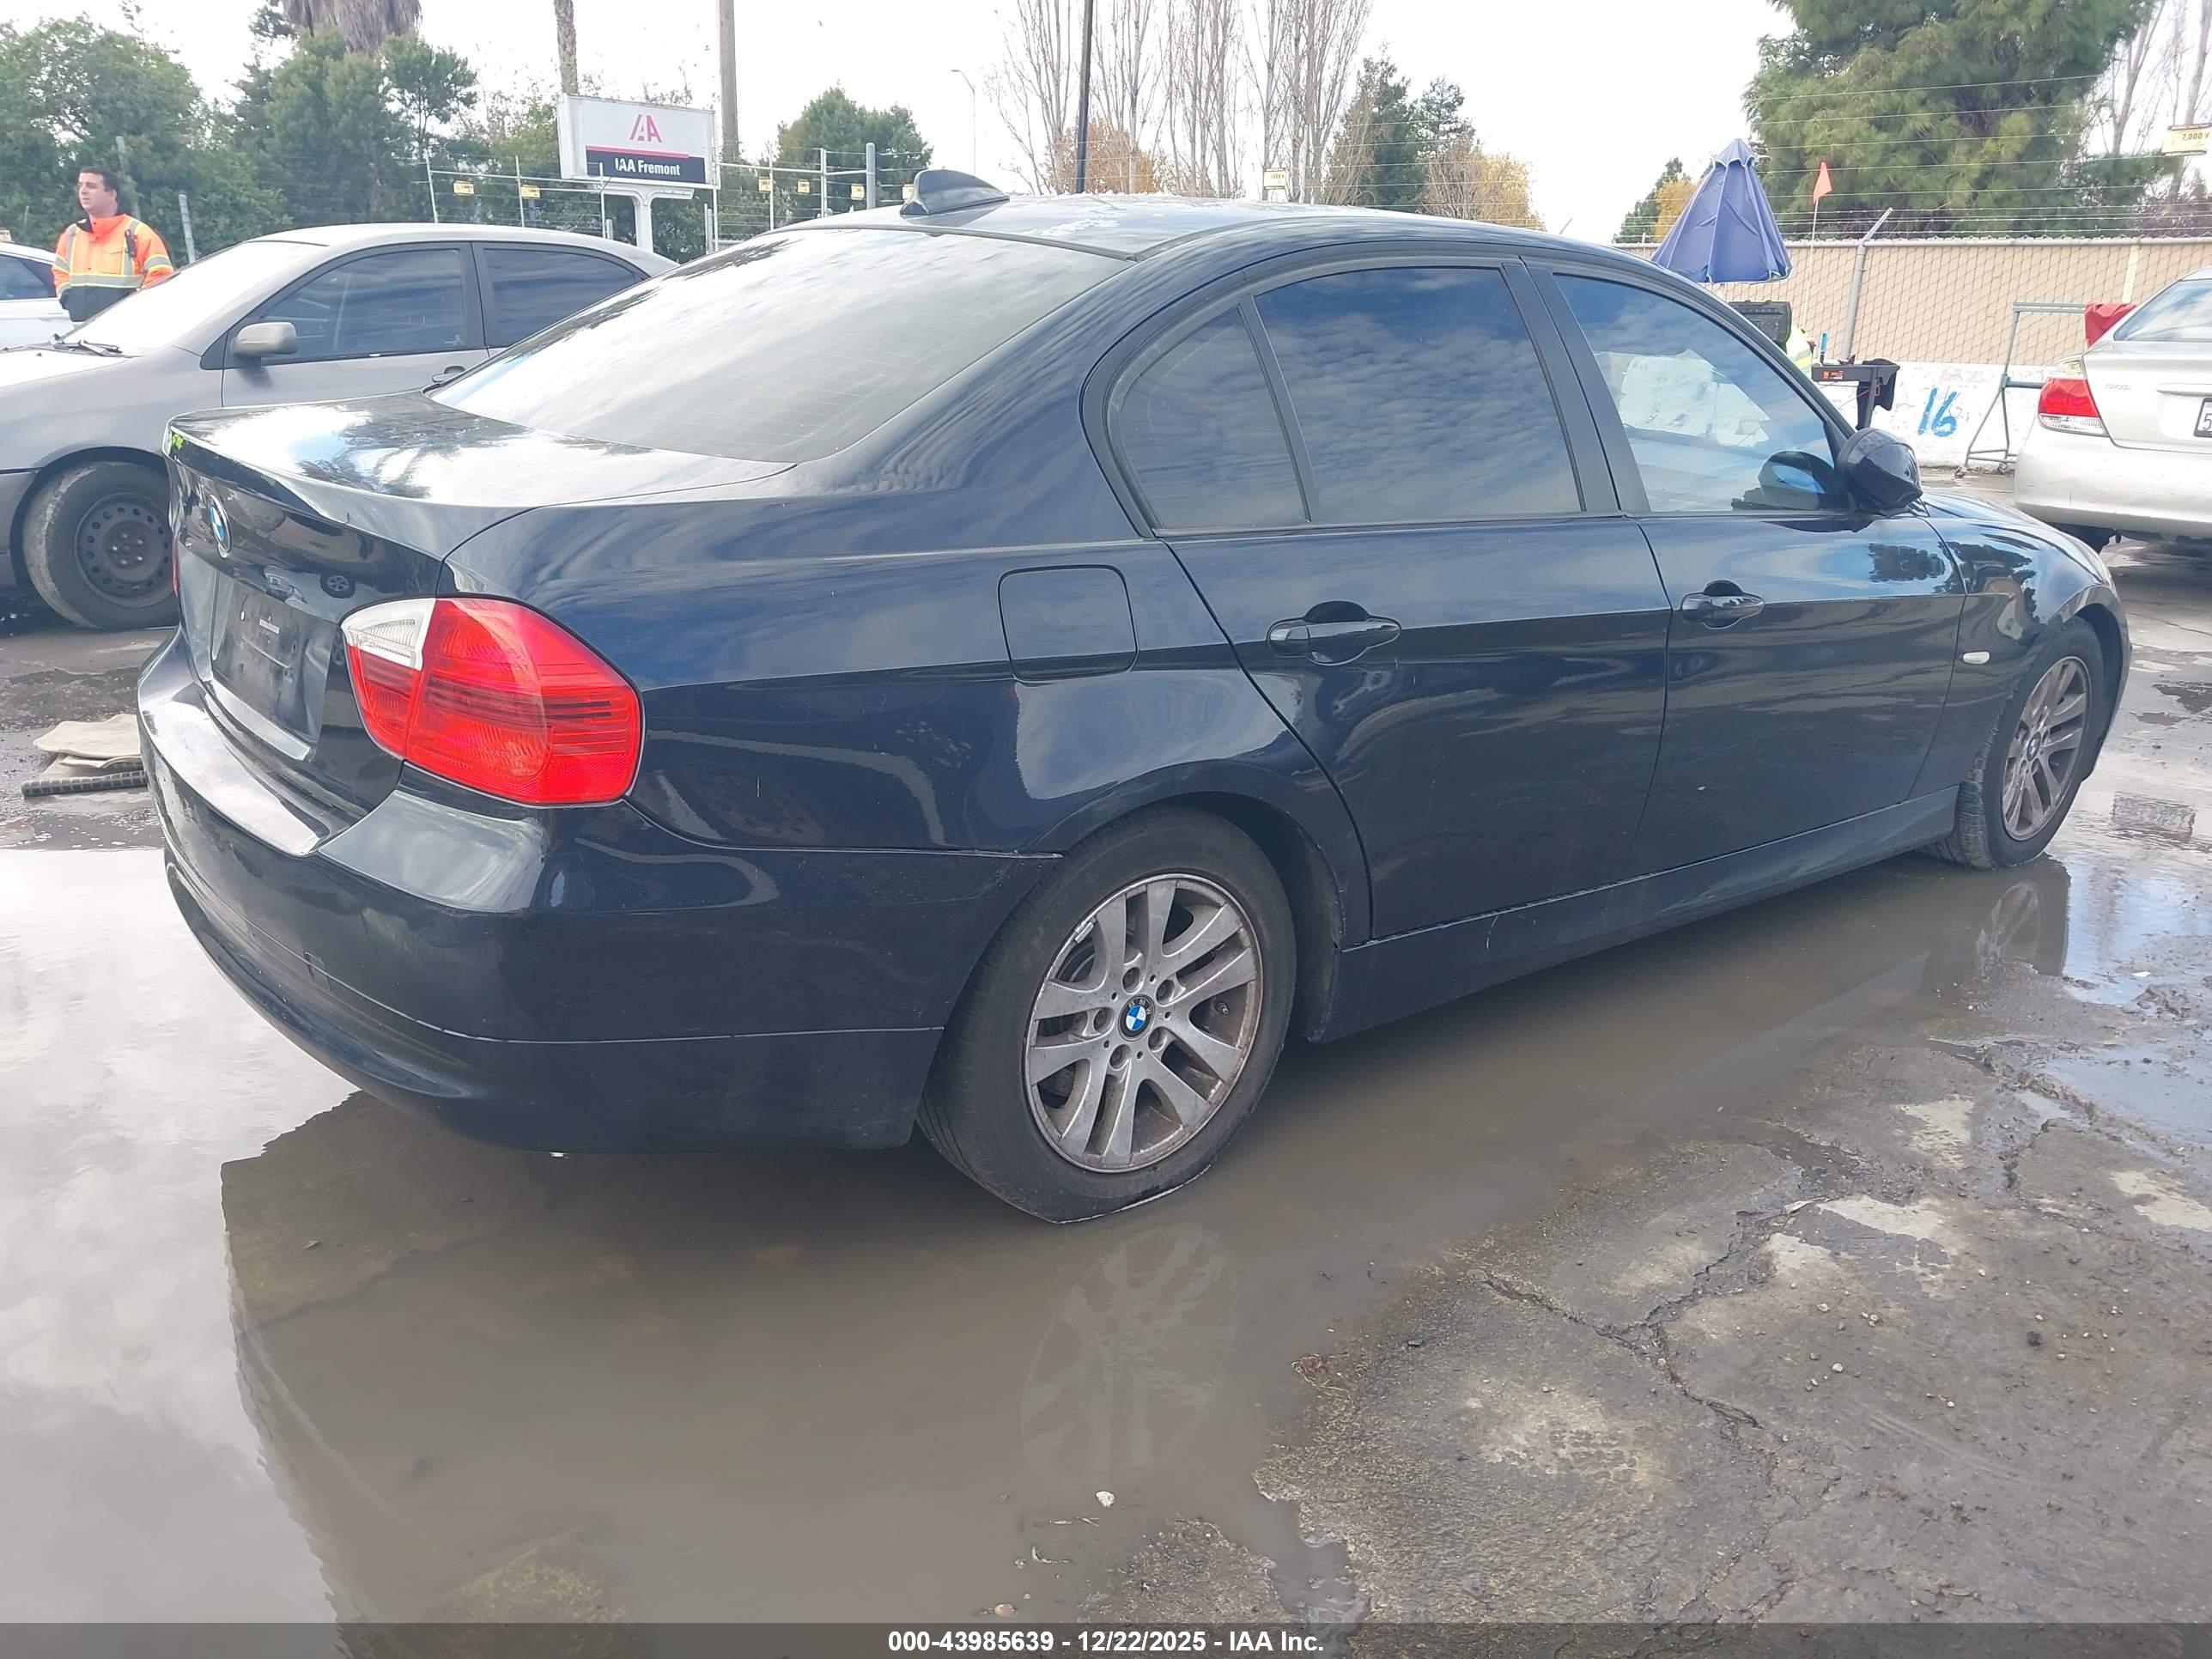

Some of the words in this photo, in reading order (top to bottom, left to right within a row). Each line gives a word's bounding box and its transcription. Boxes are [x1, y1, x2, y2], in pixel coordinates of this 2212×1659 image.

[615, 157, 636, 173] IAA
[637, 159, 681, 176] Fremont
[1917, 387, 1958, 436] 16
